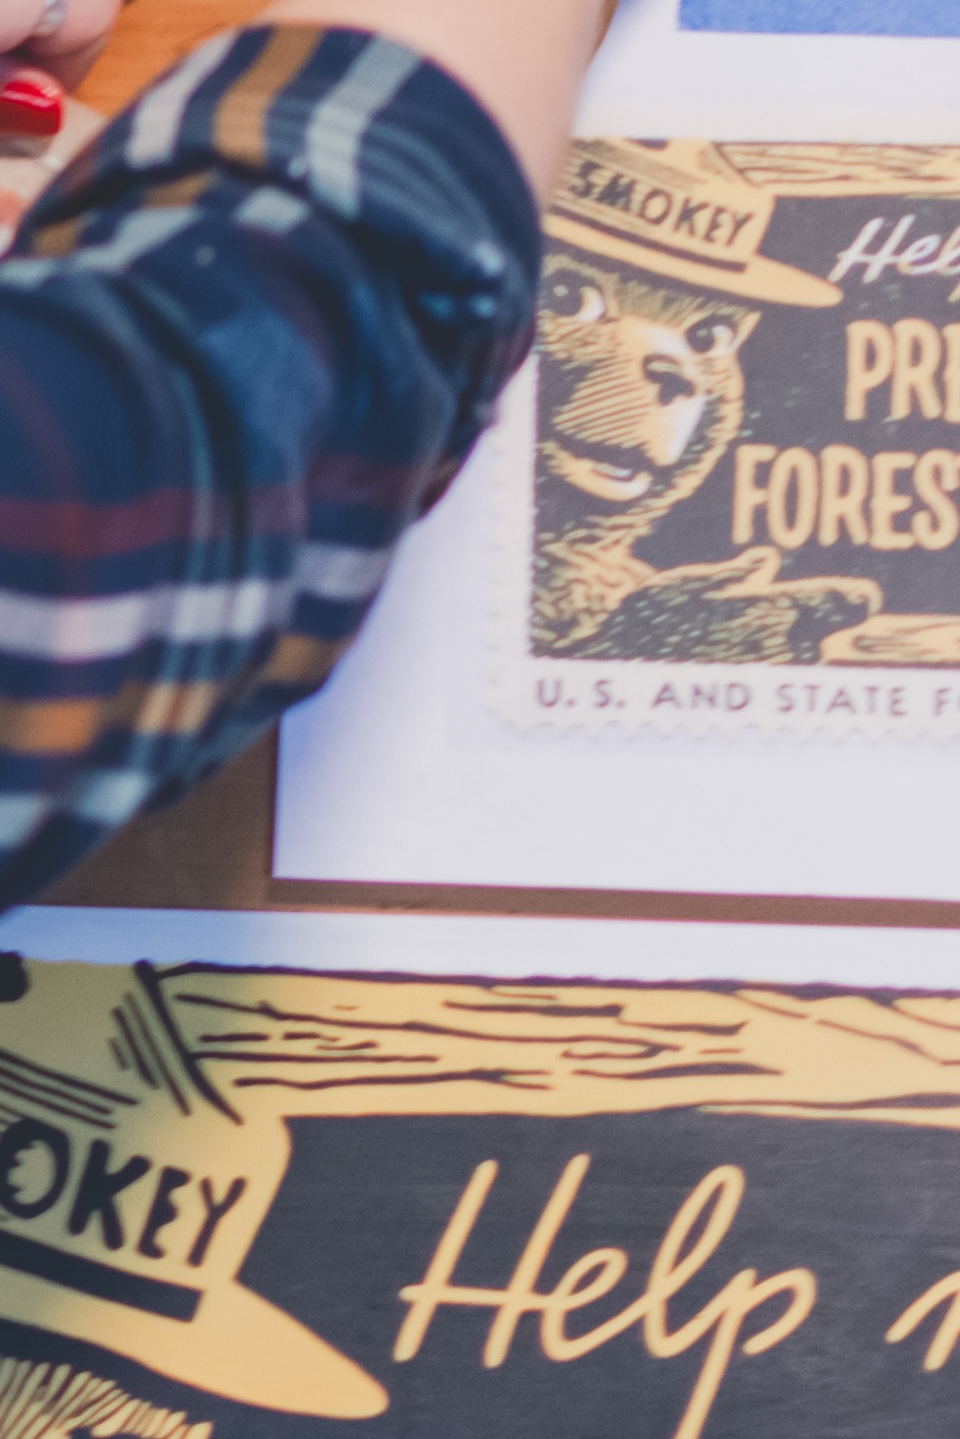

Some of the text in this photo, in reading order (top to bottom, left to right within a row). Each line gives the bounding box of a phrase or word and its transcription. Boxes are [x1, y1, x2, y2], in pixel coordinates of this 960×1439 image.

[569, 160, 754, 247] SMOKEY
[651, 682, 752, 713] AND
[776, 683, 910, 717] STATE
[392, 1152, 818, 1439] Help
